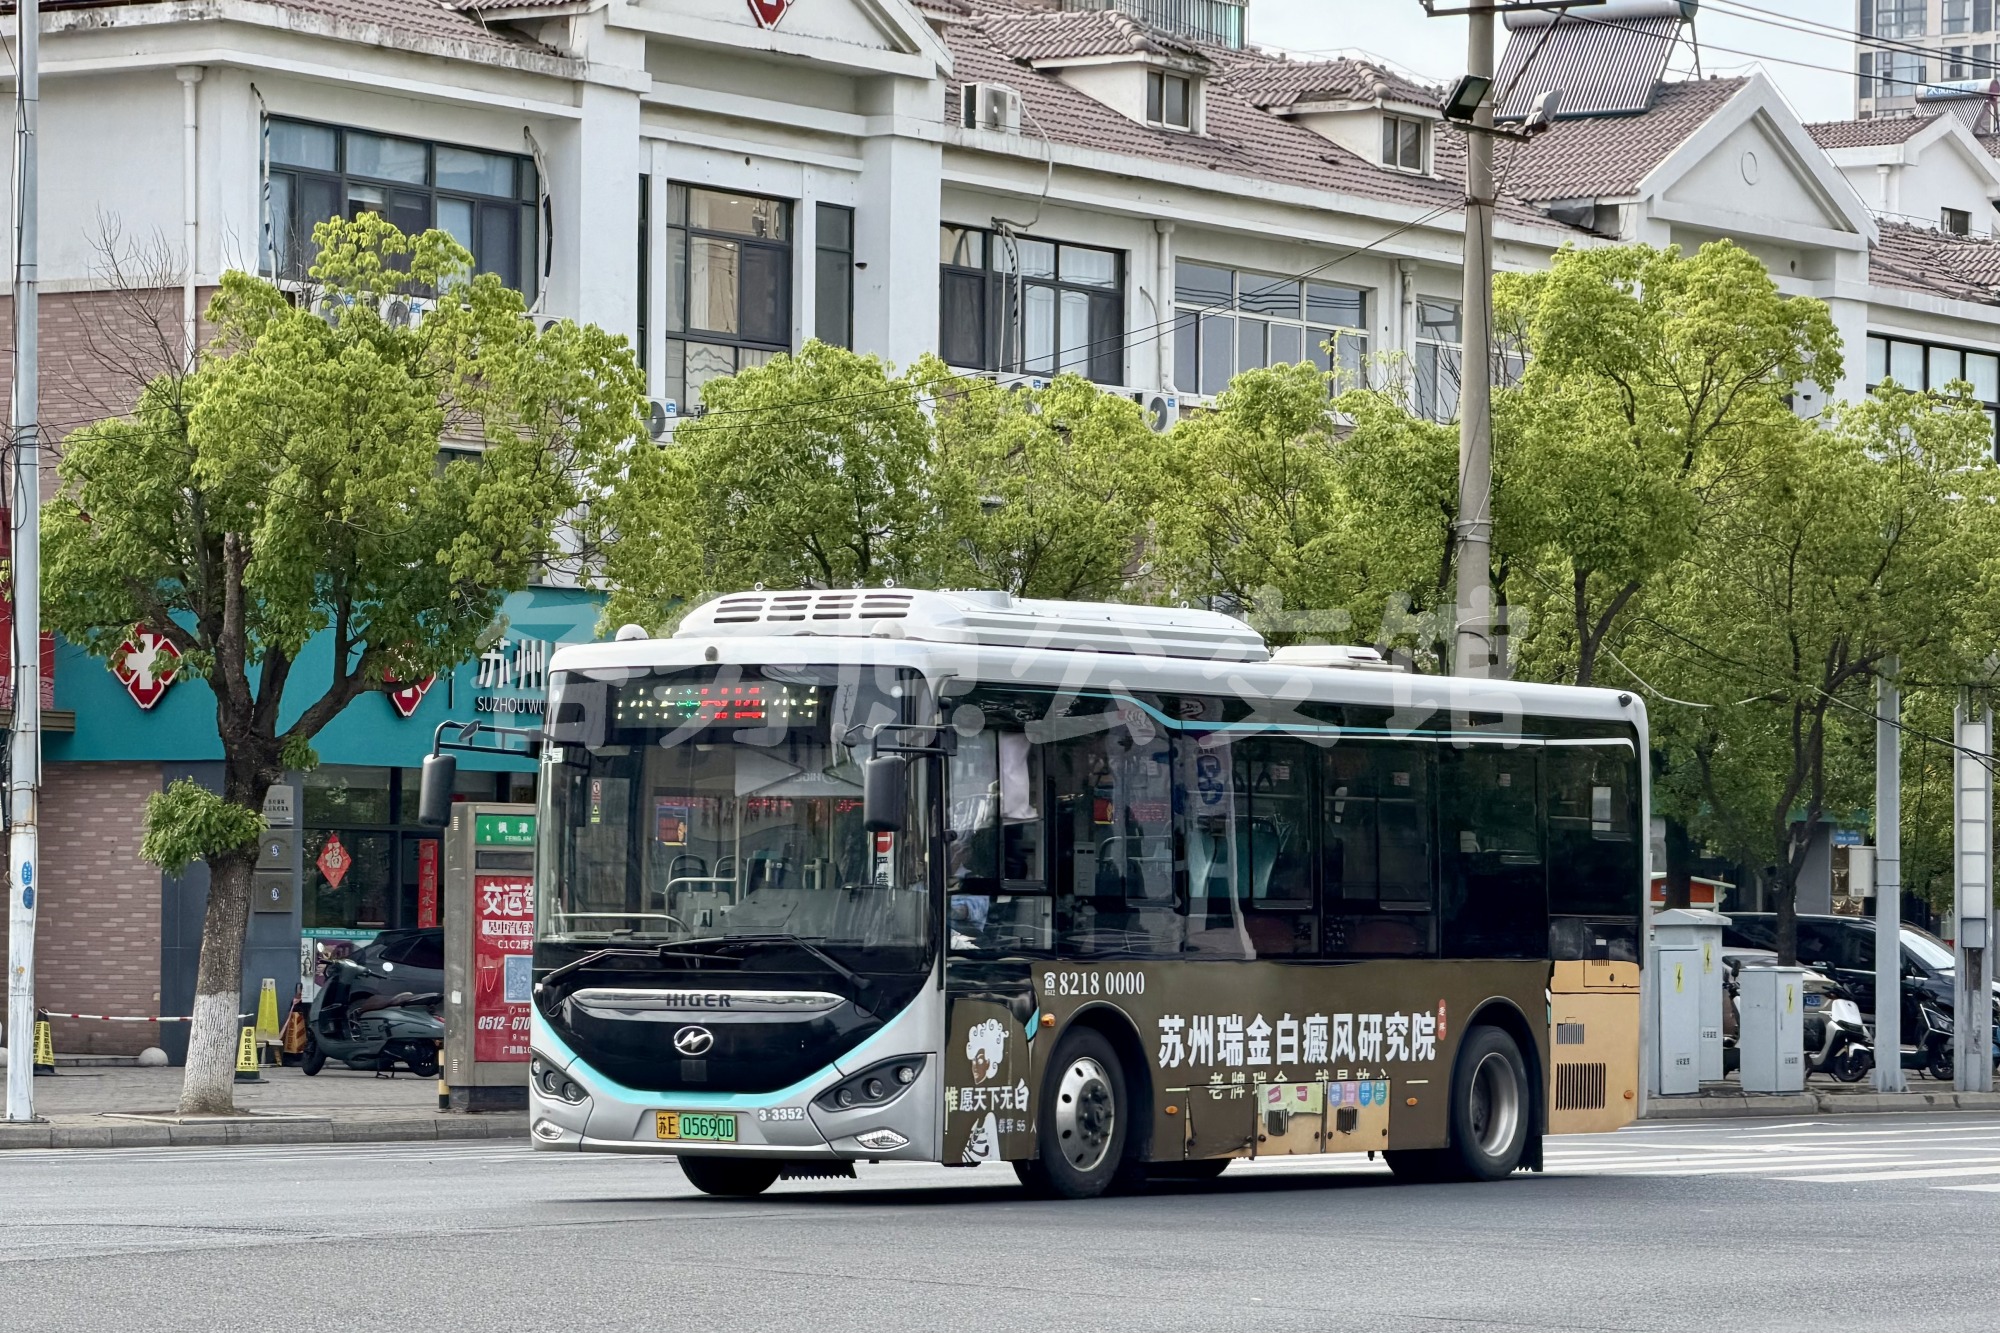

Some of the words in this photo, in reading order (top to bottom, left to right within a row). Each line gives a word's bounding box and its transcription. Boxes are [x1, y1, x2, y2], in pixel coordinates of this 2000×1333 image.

[477, 696, 525, 713] SUZHOU
[1059, 972, 1100, 995] 8218
[1105, 972, 1145, 995] 0000
[666, 993, 732, 1007] HIGER
[1158, 1011, 1436, 1068] 苏州瑞金白癜风研究院
